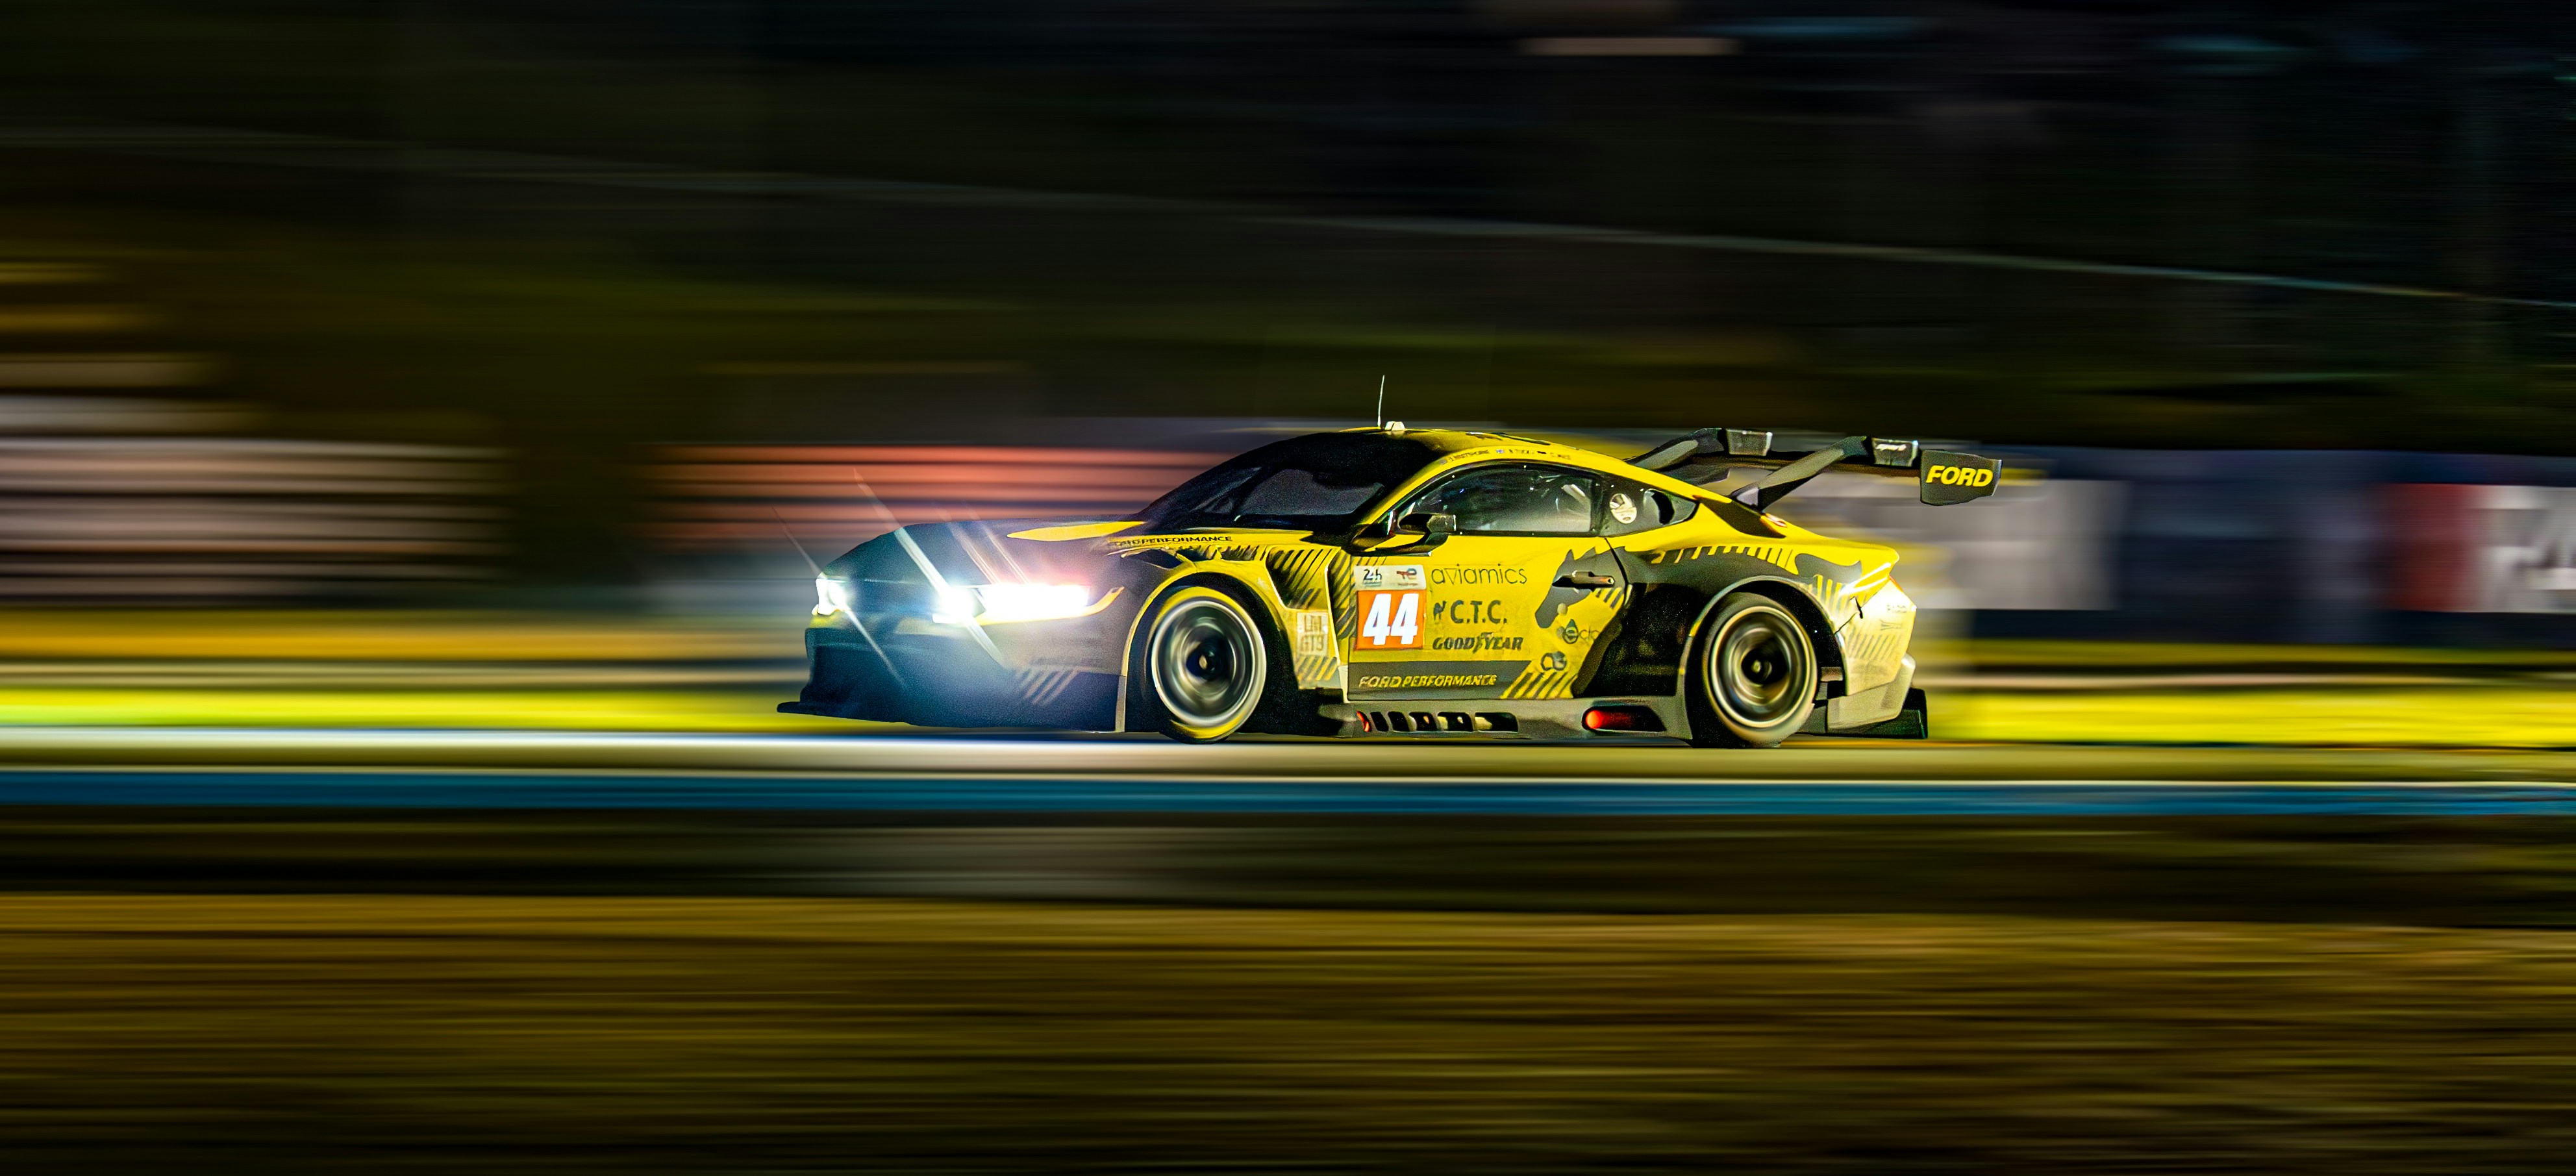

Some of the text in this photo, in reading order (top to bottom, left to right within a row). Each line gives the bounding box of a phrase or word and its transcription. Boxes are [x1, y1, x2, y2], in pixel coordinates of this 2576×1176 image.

[1926, 465, 1993, 486] FORD
[1362, 593, 1418, 645] 44
[1450, 599, 1507, 624] C.T.C.
[1432, 632, 1524, 653] GOODYEAR
